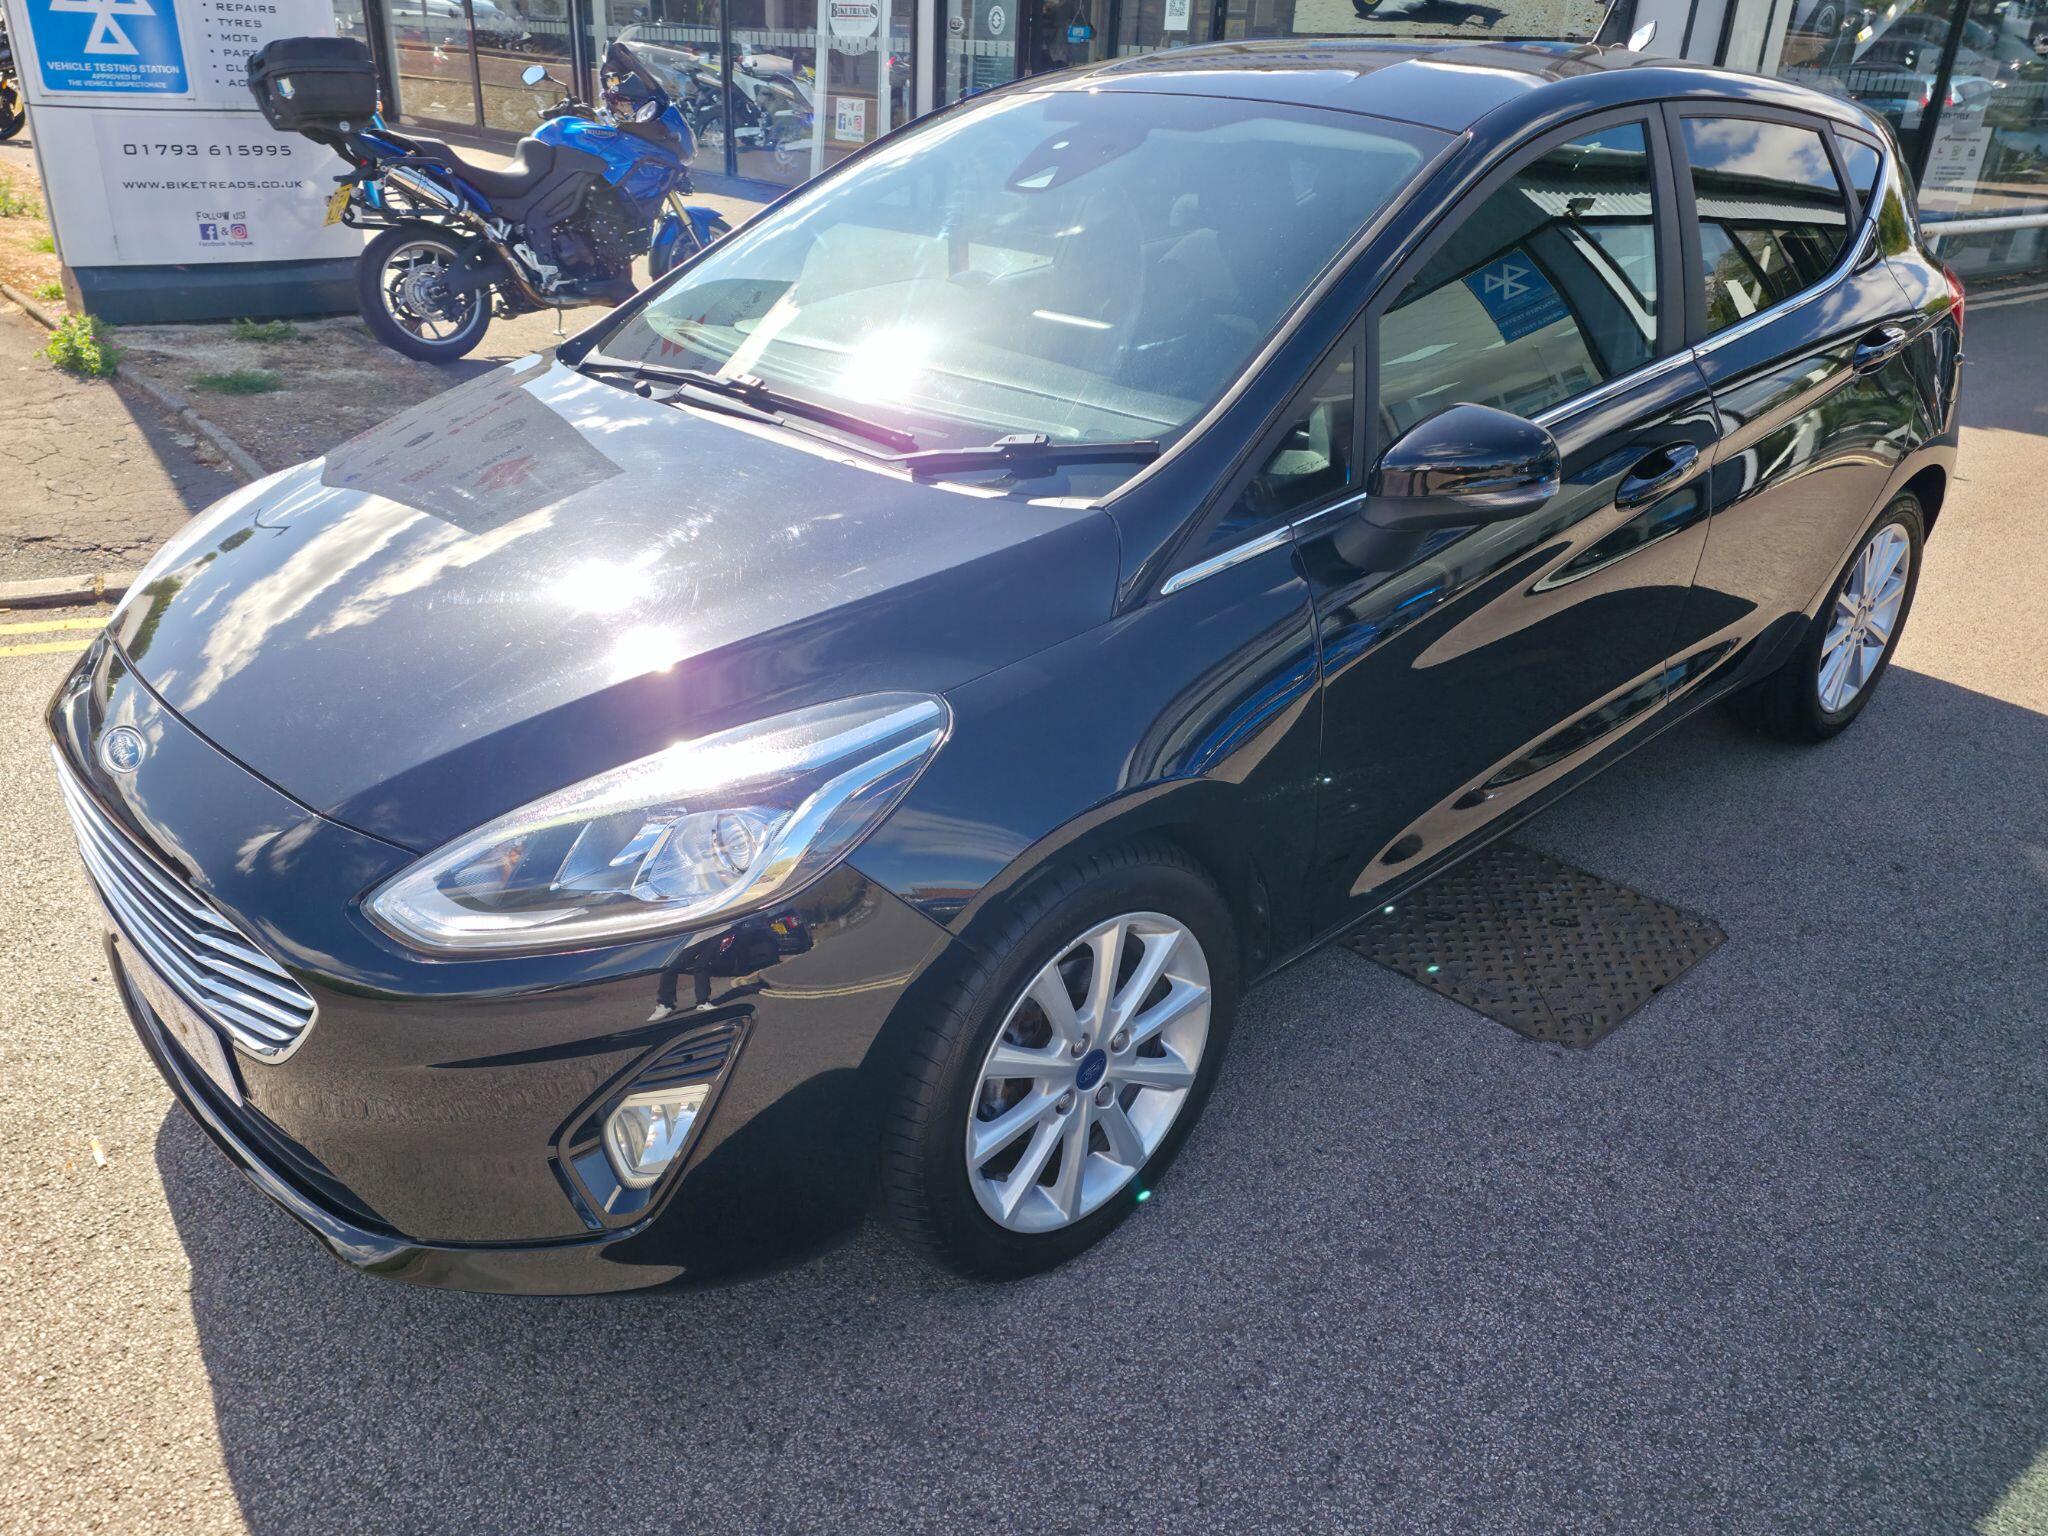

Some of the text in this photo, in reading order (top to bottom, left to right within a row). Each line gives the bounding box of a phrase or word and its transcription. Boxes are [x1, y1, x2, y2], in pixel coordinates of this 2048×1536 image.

[216, 3, 276, 13] REPAIRS
[217, 18, 262, 28] TYRES
[47, 61, 180, 74] VEHICLE TESTING STATION
[84, 80, 113, 88] VEHICLE
[115, 81, 168, 89] INSPECTORATE
[123, 144, 292, 157] 01793 615995
[122, 180, 303, 190] WWW.BIKETREADS.CO.UK
[221, 226, 229, 235] &
